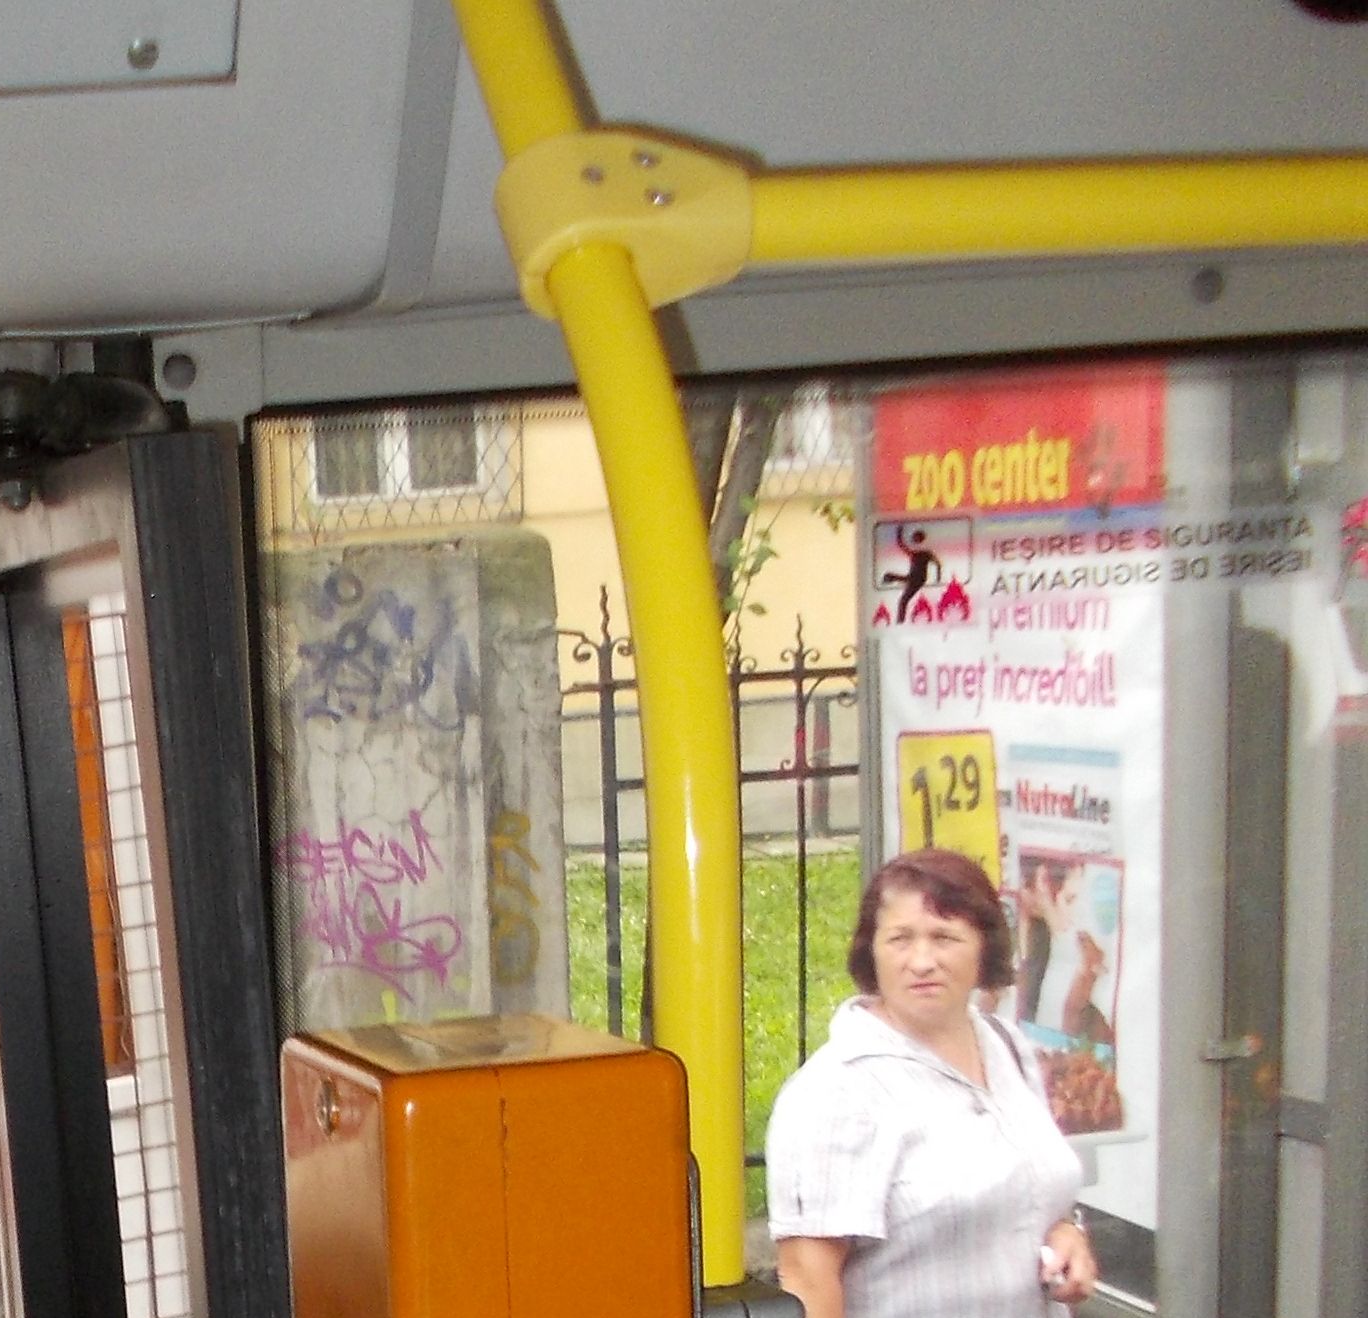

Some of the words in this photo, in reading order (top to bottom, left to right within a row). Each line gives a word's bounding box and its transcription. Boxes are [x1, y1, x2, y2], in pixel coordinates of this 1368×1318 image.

[903, 449, 965, 512] zoo
[972, 426, 1070, 505] center
[1094, 529, 1136, 554] DE
[908, 646, 928, 697] la
